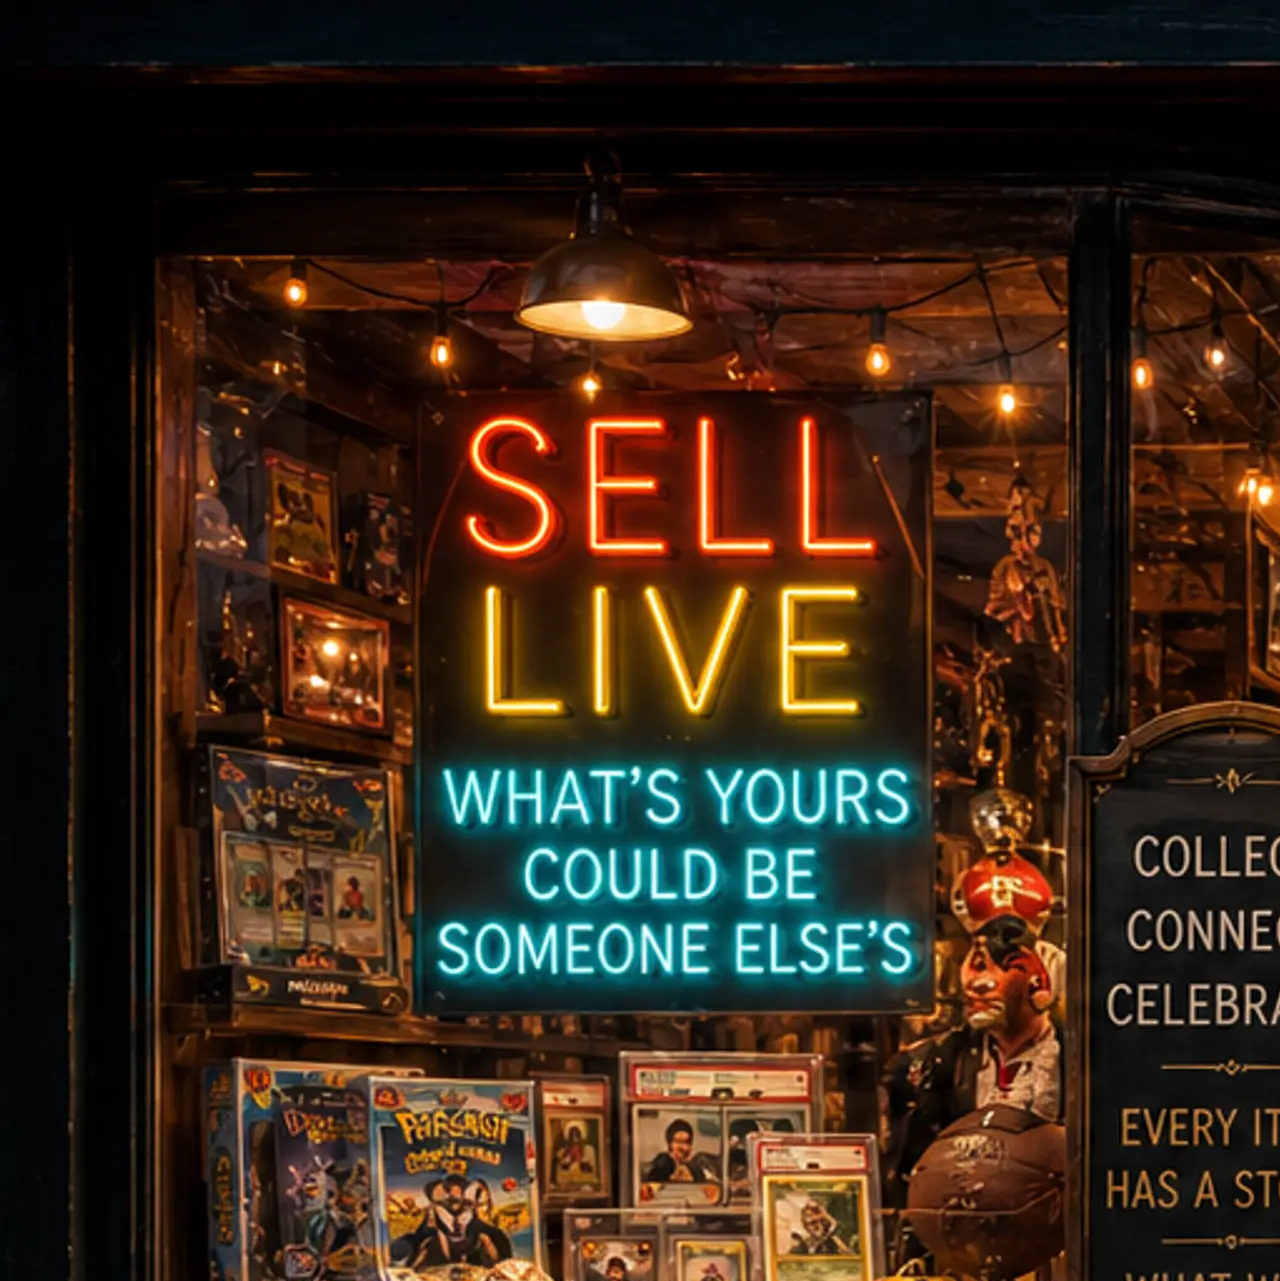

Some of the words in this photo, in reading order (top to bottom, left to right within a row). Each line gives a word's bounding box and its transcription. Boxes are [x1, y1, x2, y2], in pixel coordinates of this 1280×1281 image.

[465, 414, 878, 555] SELL
[484, 585, 861, 717] LIVE
[442, 765, 682, 826] WHAT'S
[704, 767, 910, 826] YOURS
[523, 846, 720, 902] COULD
[744, 846, 819, 902] BE
[437, 921, 711, 975] SOMEONE
[734, 919, 913, 974] ELSE'S
[1121, 1107, 1238, 1145] EVERY
[1107, 1169, 1179, 1208] HAS
[1194, 1170, 1219, 1207] A
